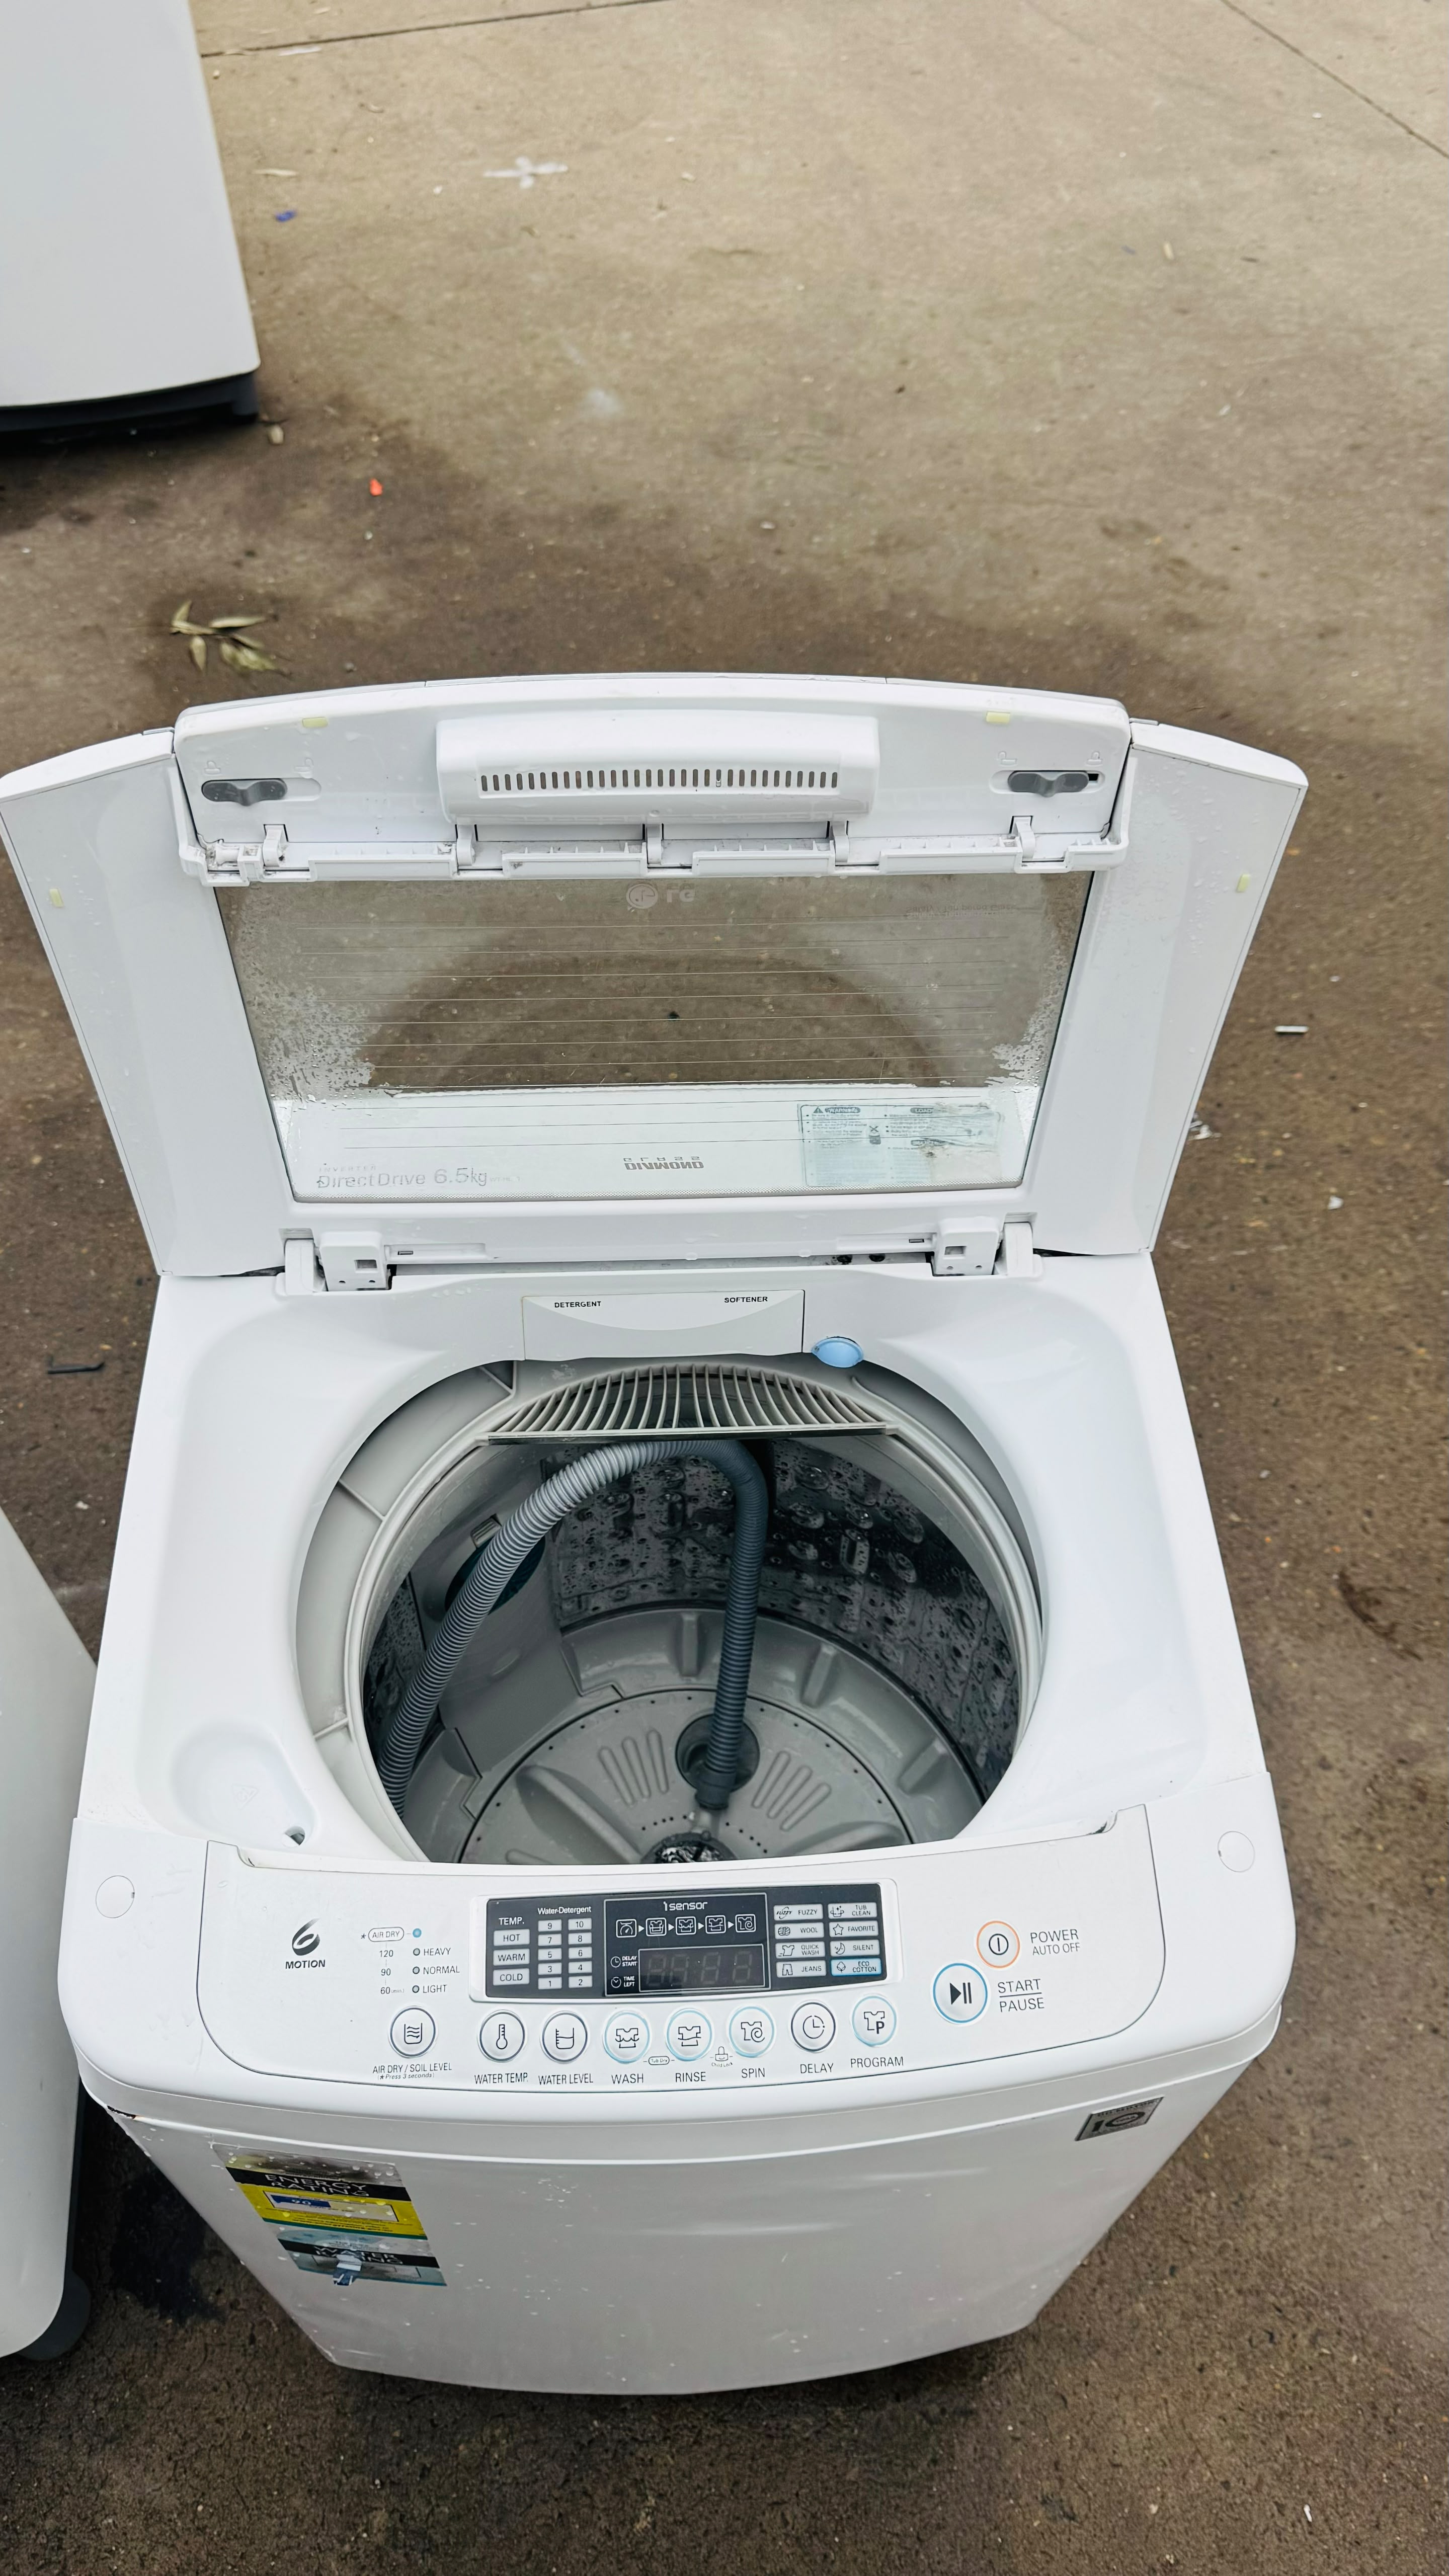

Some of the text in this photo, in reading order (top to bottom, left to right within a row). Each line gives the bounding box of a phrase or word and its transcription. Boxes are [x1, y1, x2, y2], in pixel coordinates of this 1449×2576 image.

[499, 1917, 524, 1925] TEMP.
[503, 1934, 521, 1942] HOT
[1030, 1928, 1079, 1944] POWER
[424, 1948, 451, 1956] HEAVY
[1032, 1943, 1080, 1956] AUTO OFF
[498, 1954, 525, 1962] WARM
[285, 1959, 325, 1969] MOTION
[423, 1966, 460, 1975] NORMAL
[500, 1973, 523, 1981] COLD
[423, 1984, 447, 1993] LIGHT
[998, 1978, 1041, 1993] START
[999, 1997, 1044, 2013] PAUSE
[851, 2056, 904, 2068] PROGRAM
[373, 2065, 385, 2073] AIR
[387, 2065, 403, 2073] DRY
[410, 2063, 427, 2072] SOIL
[430, 2063, 452, 2071] LEVEL
[741, 2068, 765, 2078] SPIN
[800, 2063, 834, 2073] DELAY
[474, 2072, 528, 2084] WATER TEMP.
[538, 2073, 593, 2085] WATER LEVEL
[611, 2073, 643, 2084] WASH
[676, 2071, 706, 2082] RINSE
[265, 2175, 367, 2190] ENERGY
[271, 2181, 369, 2197] RATING
